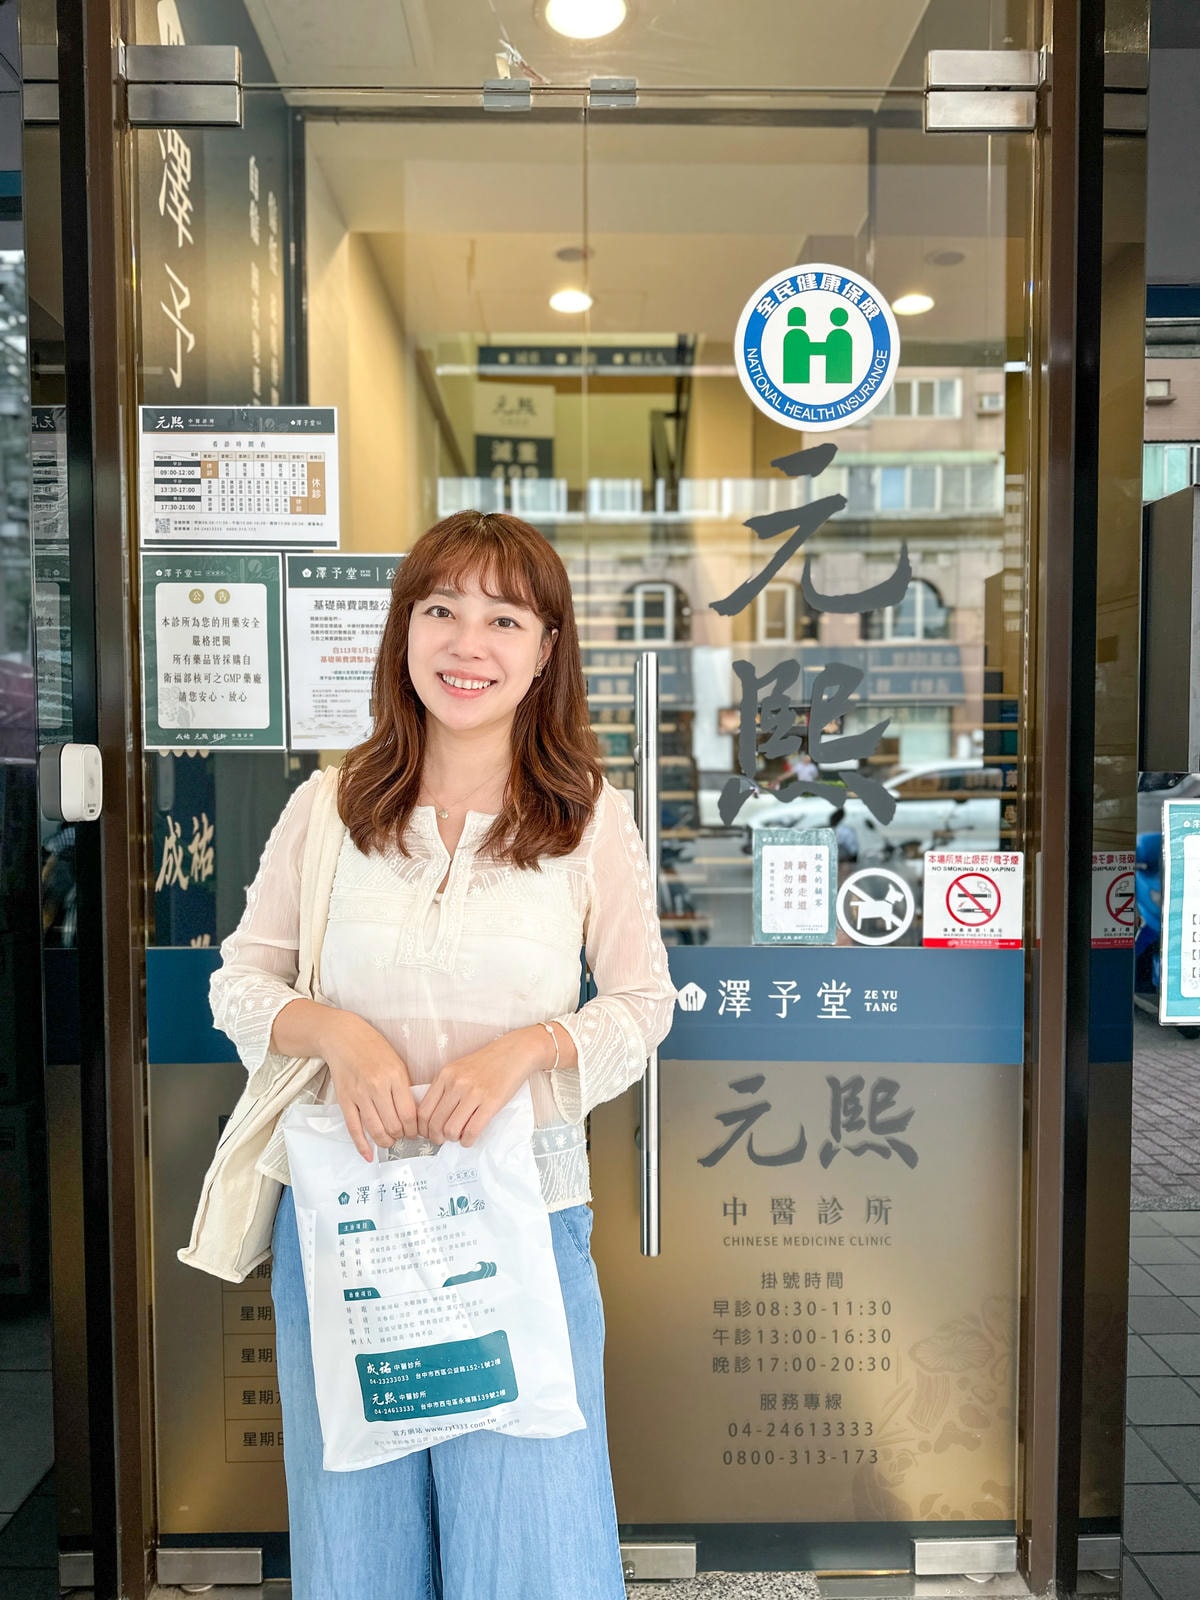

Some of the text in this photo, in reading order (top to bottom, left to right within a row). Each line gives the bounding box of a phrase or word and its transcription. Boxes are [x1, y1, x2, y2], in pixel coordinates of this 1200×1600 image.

[756, 272, 881, 321] 全民健康保險
[747, 347, 888, 421] NATIONAL HEALTH INSURANCE
[155, 415, 184, 429] 元熙
[311, 478, 321, 499] 休診
[164, 569, 192, 578] 澤予堂
[316, 567, 357, 579] 澤予堂
[161, 616, 260, 628] 本診所為您的用藥安全
[192, 635, 231, 646] 嚴格把關
[709, 442, 912, 828] 元熙
[172, 654, 251, 665] 所有藥品皆採購自
[178, 691, 247, 702] 請您安心、放心
[155, 812, 215, 893] 成祐
[929, 855, 1019, 865] 本場所禁止吸菸/電子煙
[784, 861, 793, 910] 請勿停車
[798, 861, 807, 910] 騎樓走道
[718, 979, 852, 1019] 澤予堂
[864, 990, 898, 999] ZE YU
[864, 1003, 898, 1012] TANG
[697, 1073, 919, 1169] 元熙
[356, 1181, 408, 1204] 澤予堂
[722, 1196, 892, 1226] 中醫診所
[723, 1236, 892, 1247] CHINESE MEDICINE CLINIC
[761, 1271, 844, 1289] 掛號時間
[713, 1300, 891, 1318] 早診08:30-11:30
[713, 1328, 891, 1345] 午診13:00-16:30
[366, 1359, 422, 1376] 成祐 中醫診所
[713, 1357, 891, 1374] 晚診17:00-20:30
[372, 1390, 427, 1406] 元熙 中醫診所
[760, 1393, 842, 1411] 服務專線
[728, 1422, 873, 1437] 04-24613333
[723, 1450, 878, 1465] 0800-313-173
